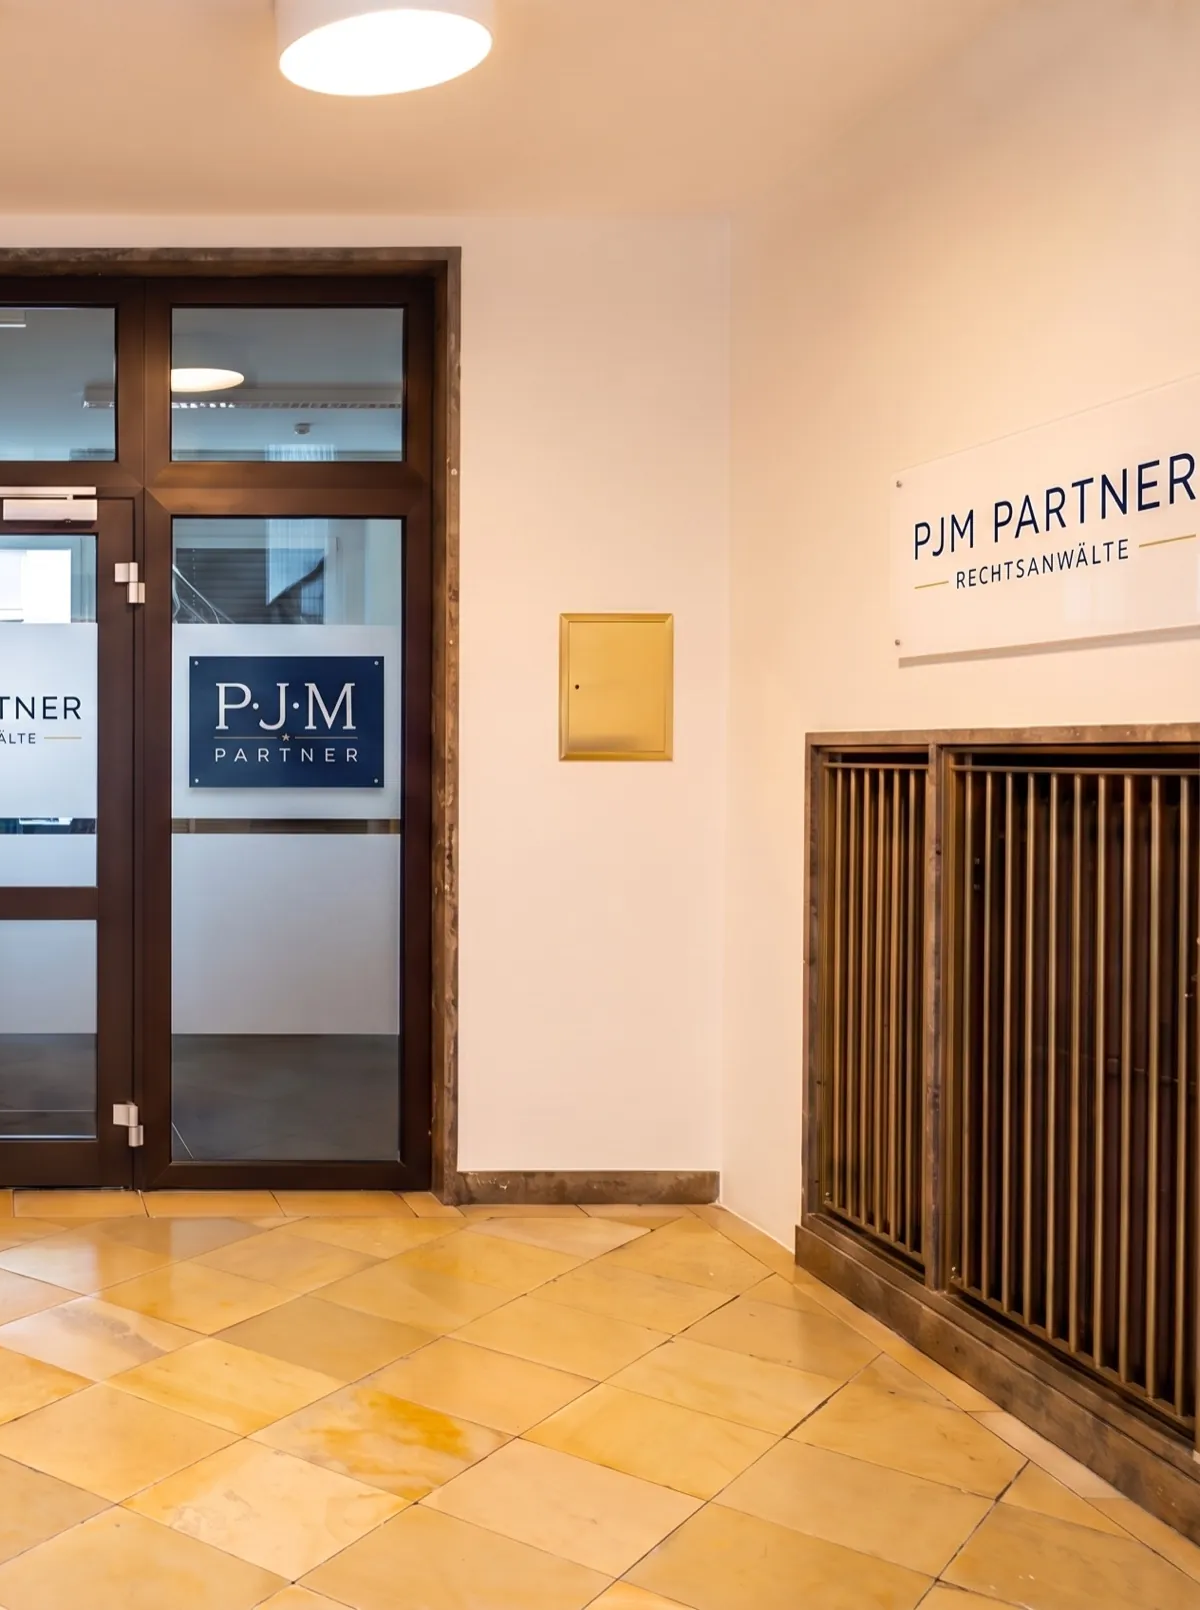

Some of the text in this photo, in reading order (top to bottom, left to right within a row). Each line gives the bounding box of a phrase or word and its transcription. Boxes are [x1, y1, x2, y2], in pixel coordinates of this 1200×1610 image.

[914, 453, 1196, 560] PJM PARTNER
[956, 539, 1129, 589] RECHTSANWÄLTE
[215, 748, 358, 762] PARTNER
